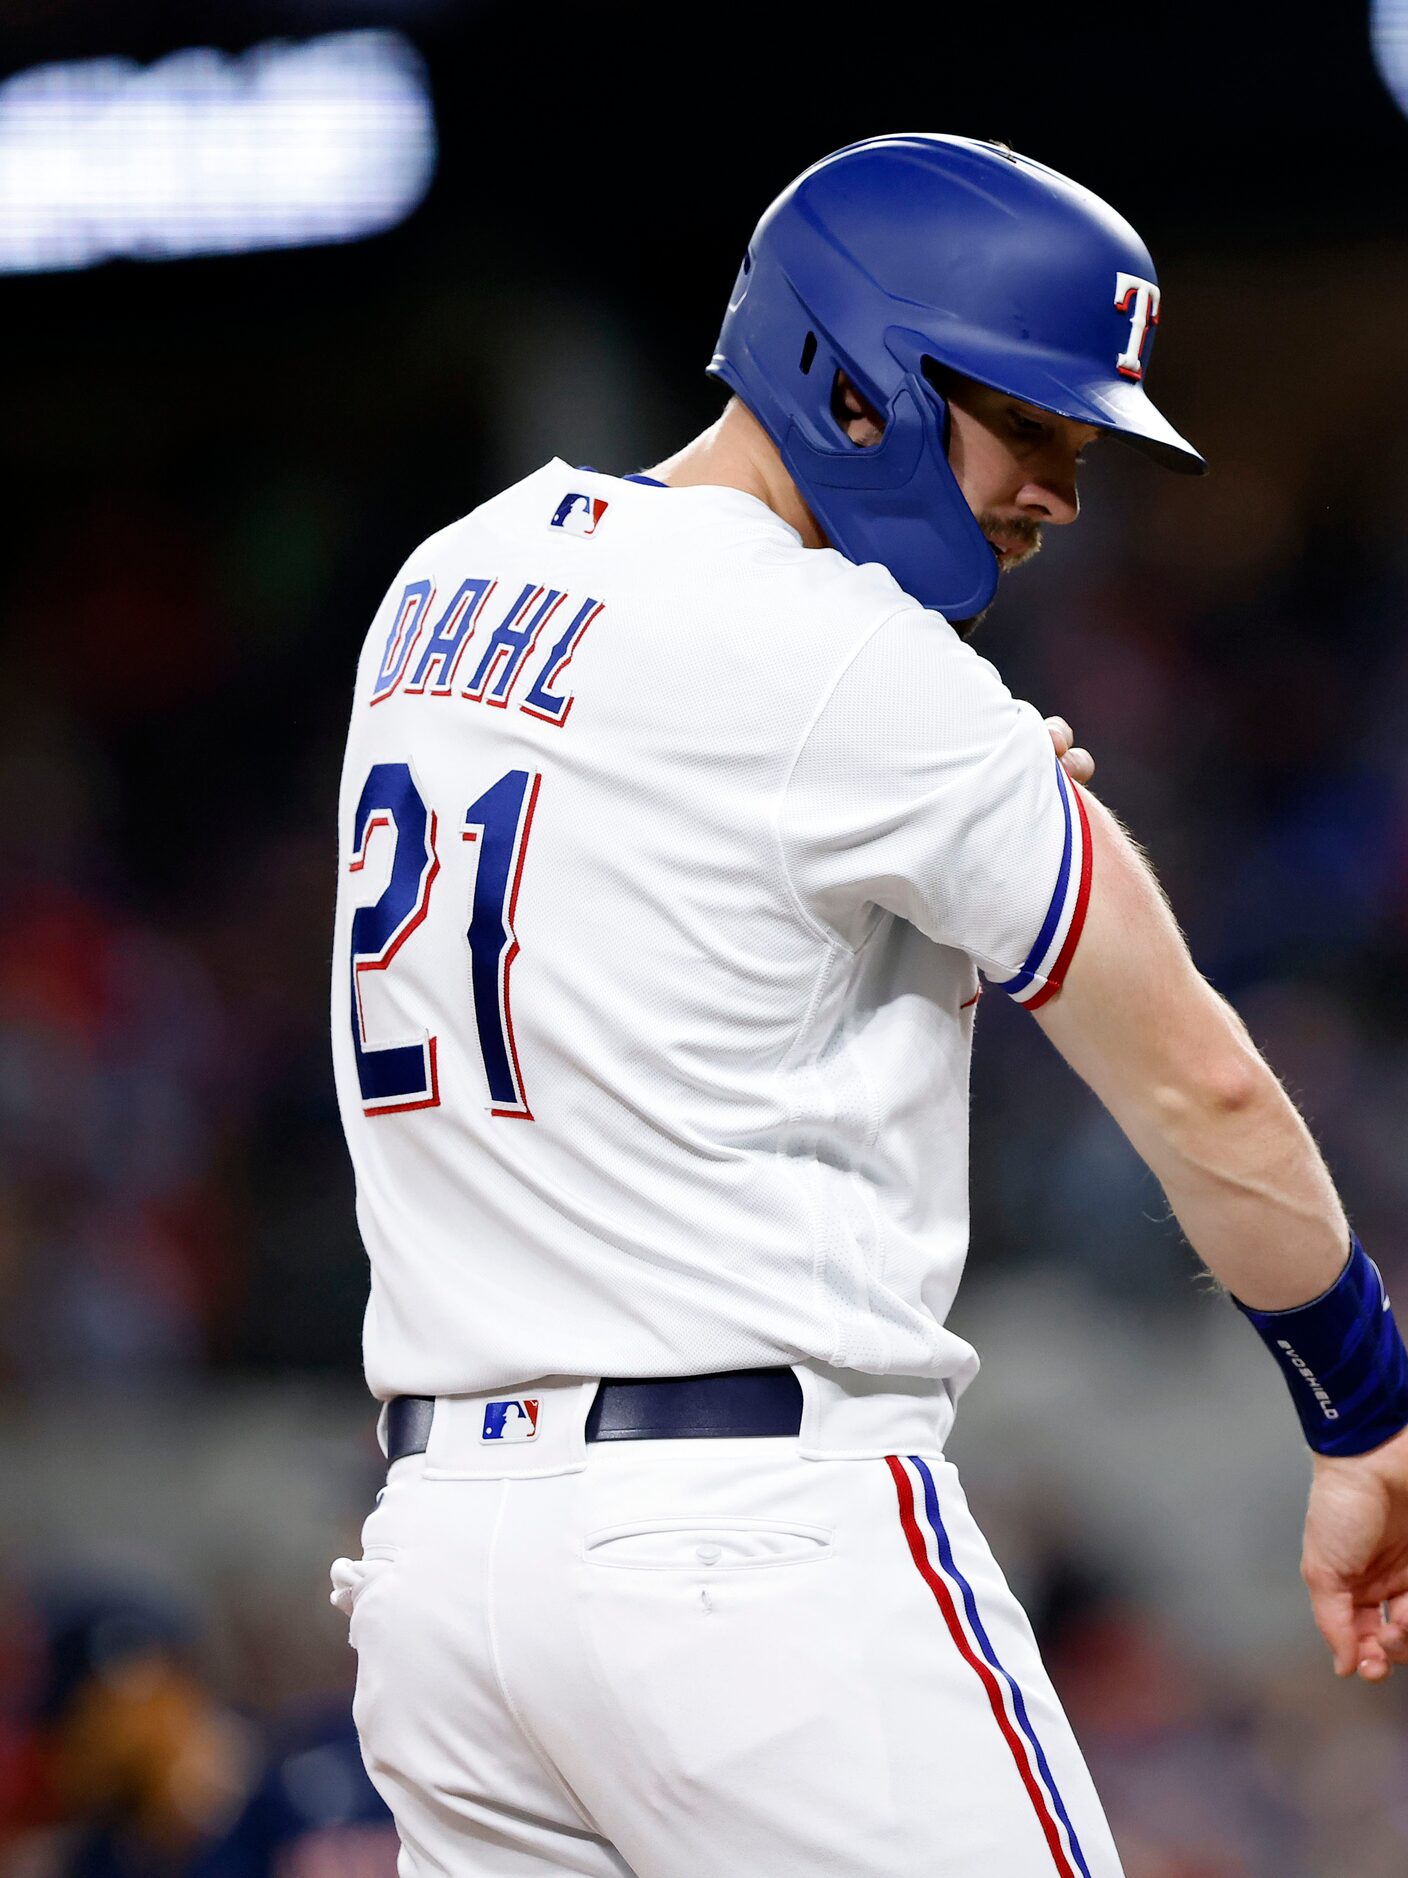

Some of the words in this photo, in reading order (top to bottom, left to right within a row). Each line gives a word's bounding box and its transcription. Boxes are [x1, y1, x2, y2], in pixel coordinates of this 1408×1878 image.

[1114, 271, 1161, 380] T
[369, 577, 606, 727] DAHL
[348, 759, 542, 1121] 21
